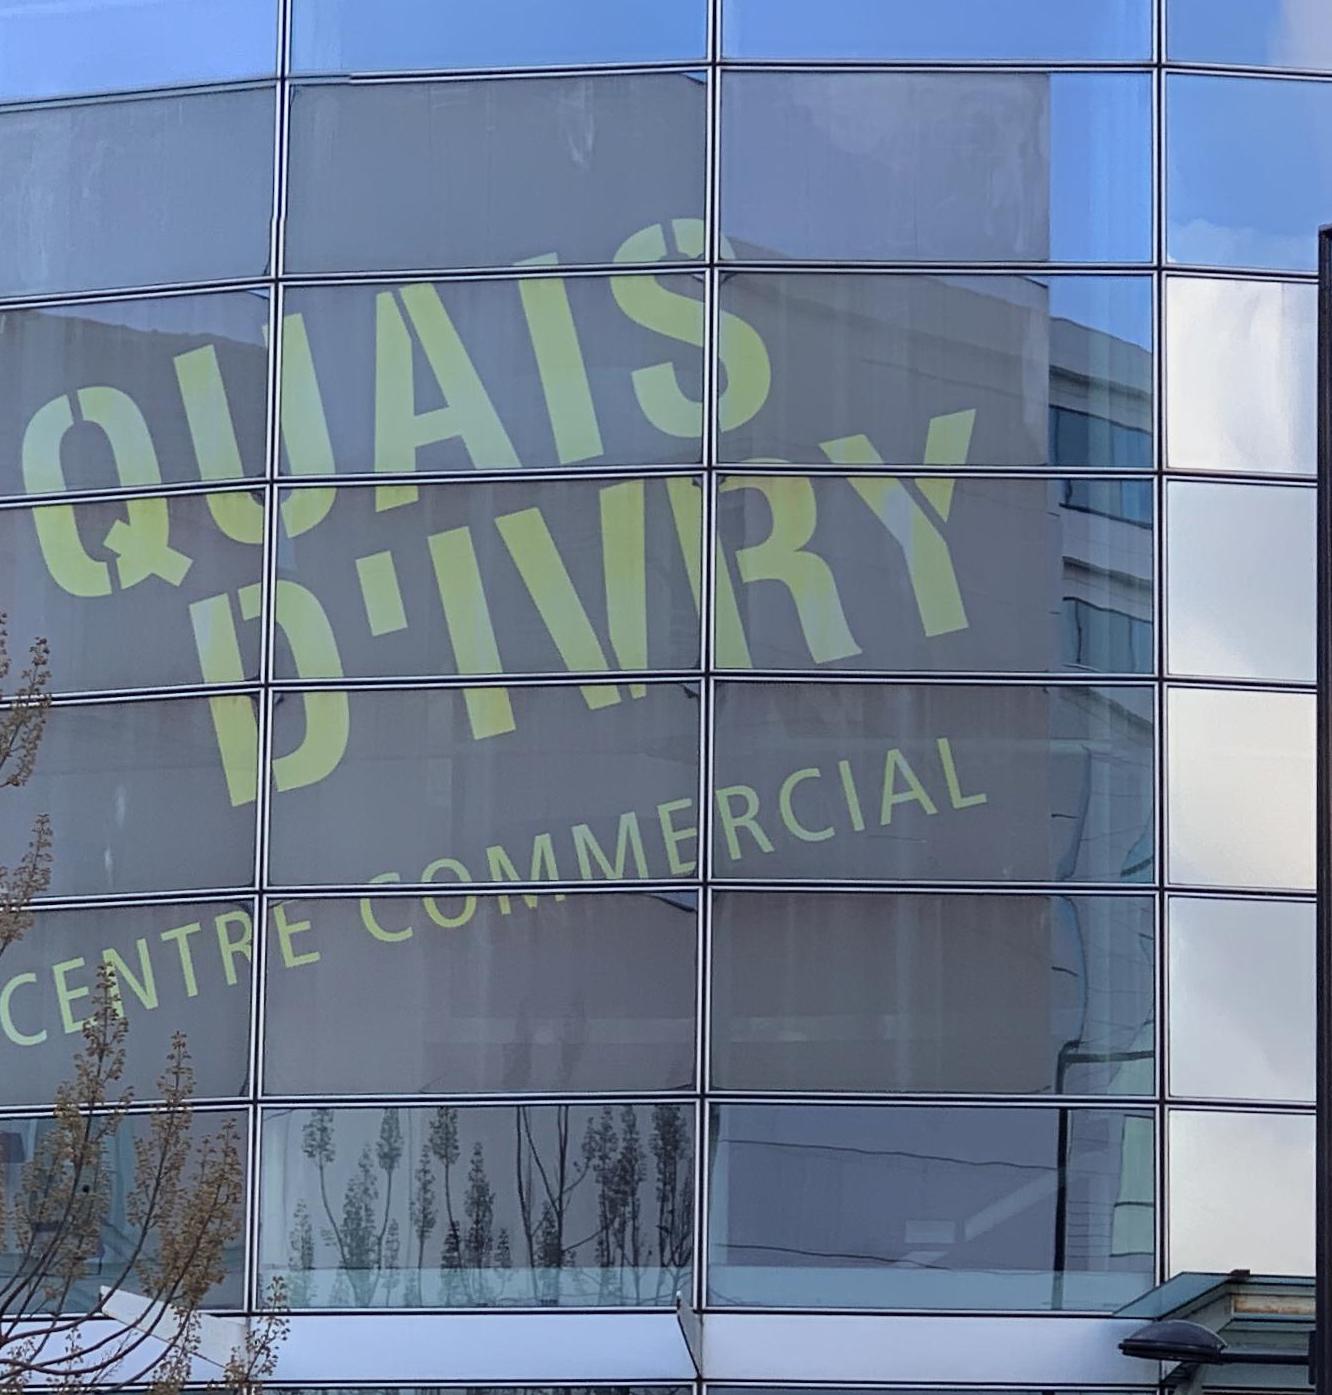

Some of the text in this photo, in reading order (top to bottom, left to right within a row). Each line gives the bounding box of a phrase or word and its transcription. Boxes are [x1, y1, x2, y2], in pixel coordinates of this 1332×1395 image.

[21, 218, 772, 598] QUAIS
[189, 409, 976, 806] D'IVRY
[0, 737, 987, 1045] CENTRE COMMERCIAL
